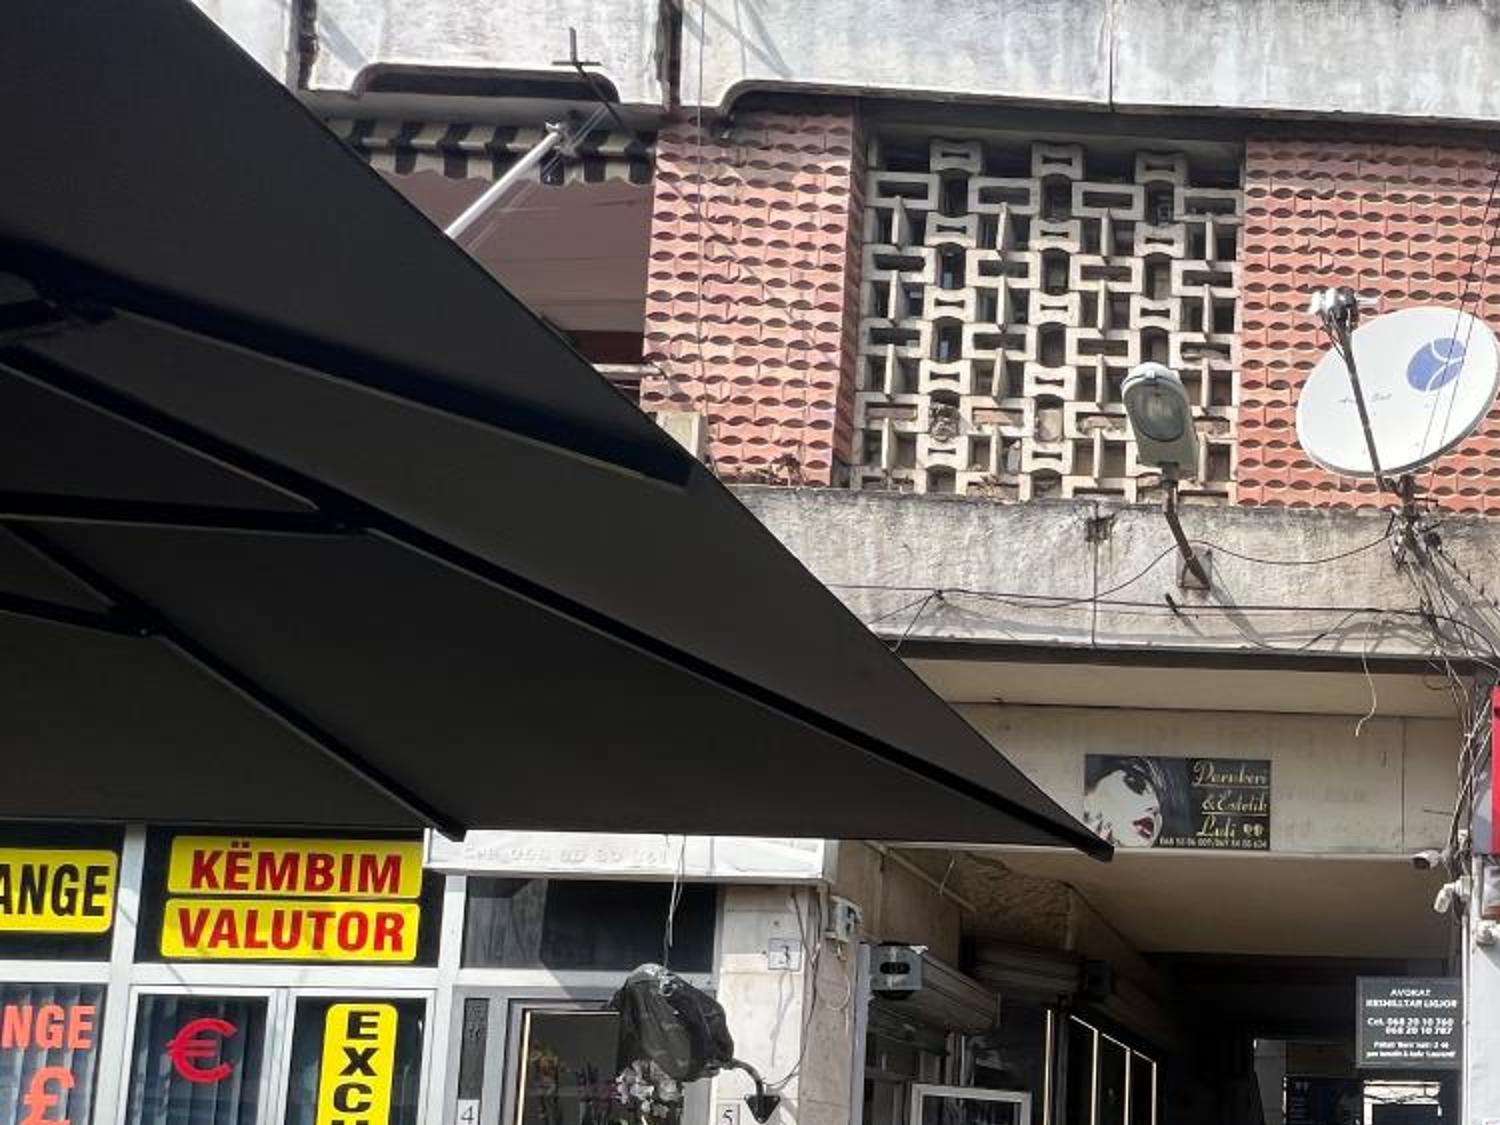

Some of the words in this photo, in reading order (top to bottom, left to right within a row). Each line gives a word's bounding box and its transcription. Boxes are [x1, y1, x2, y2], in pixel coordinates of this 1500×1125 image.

[190, 841, 402, 895] KËMBIM
[177, 907, 405, 952] VALUTOR
[460, 1105, 474, 1122] 4
